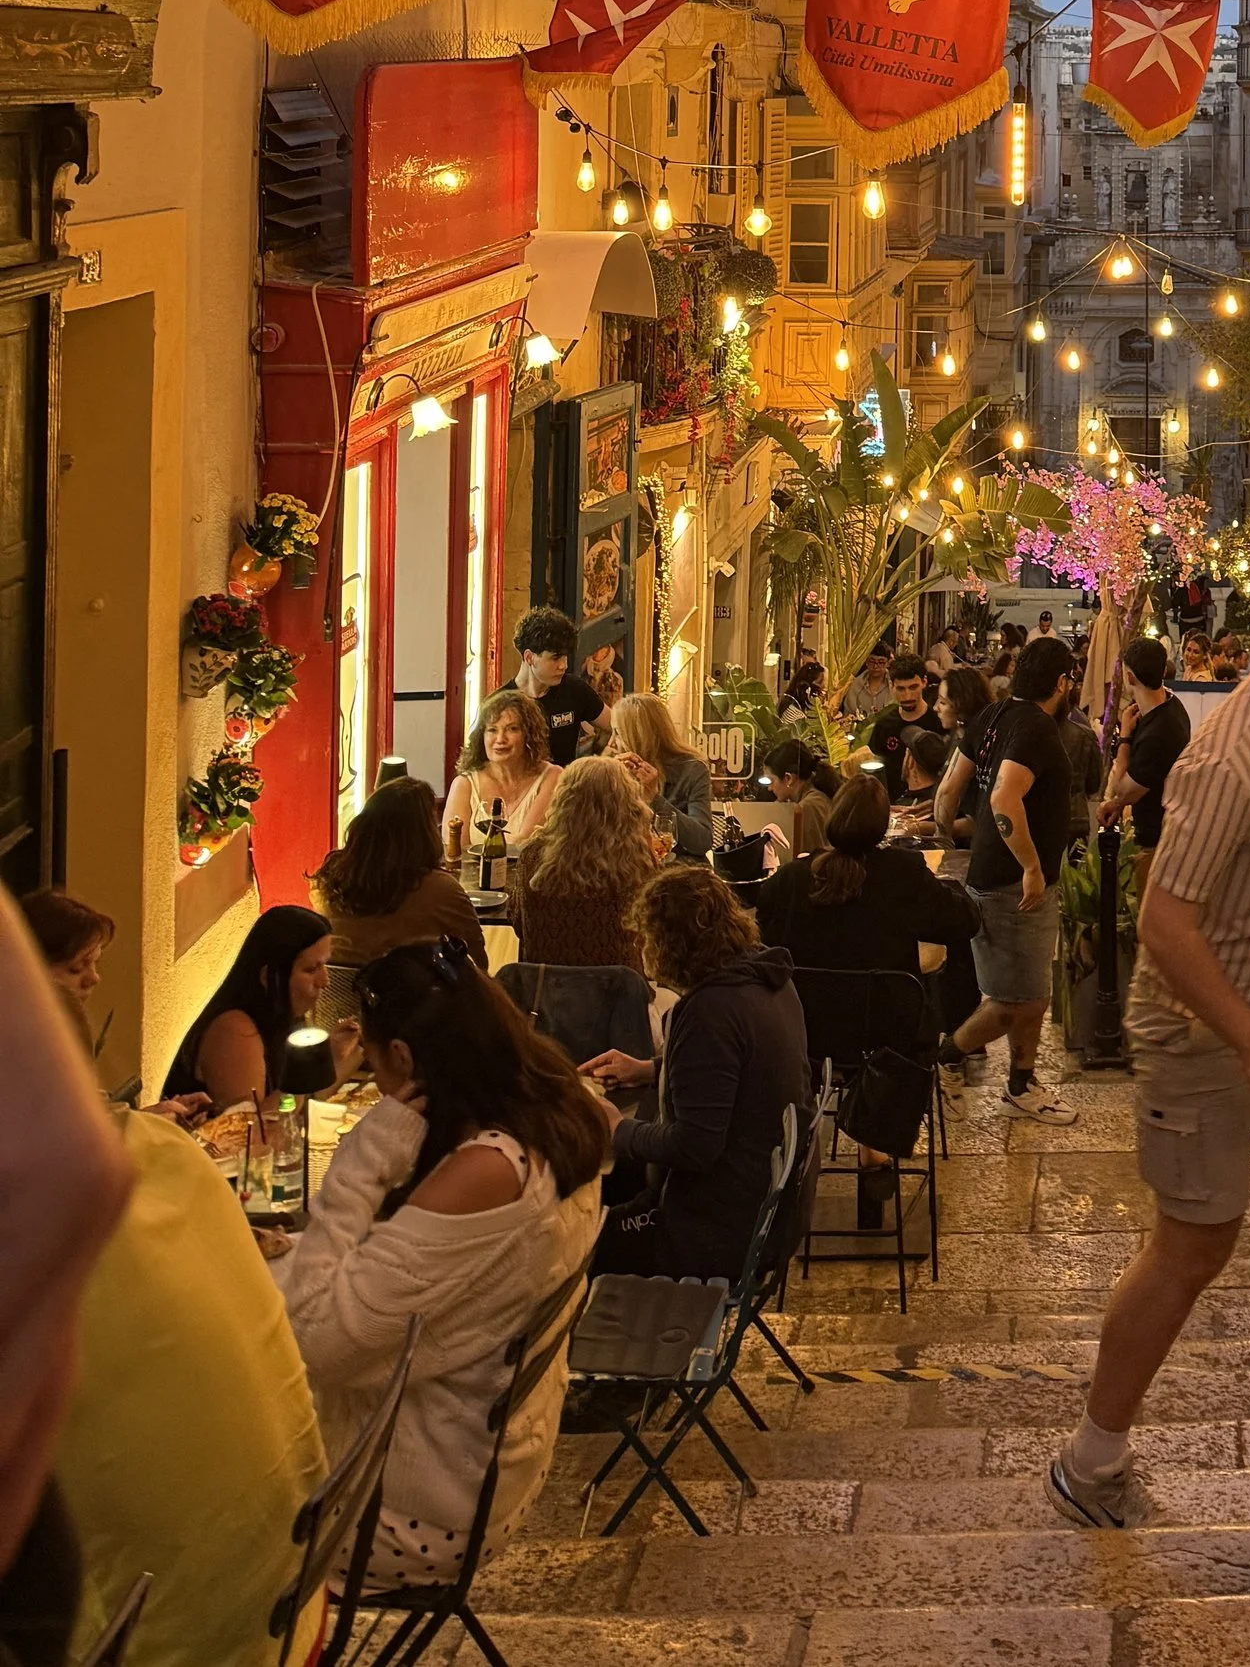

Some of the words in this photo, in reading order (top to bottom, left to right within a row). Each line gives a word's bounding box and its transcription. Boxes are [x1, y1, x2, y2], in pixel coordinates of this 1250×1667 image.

[826, 17, 959, 64] VALLETTA
[822, 46, 856, 68] Città
[859, 53, 955, 87] Umilissima
